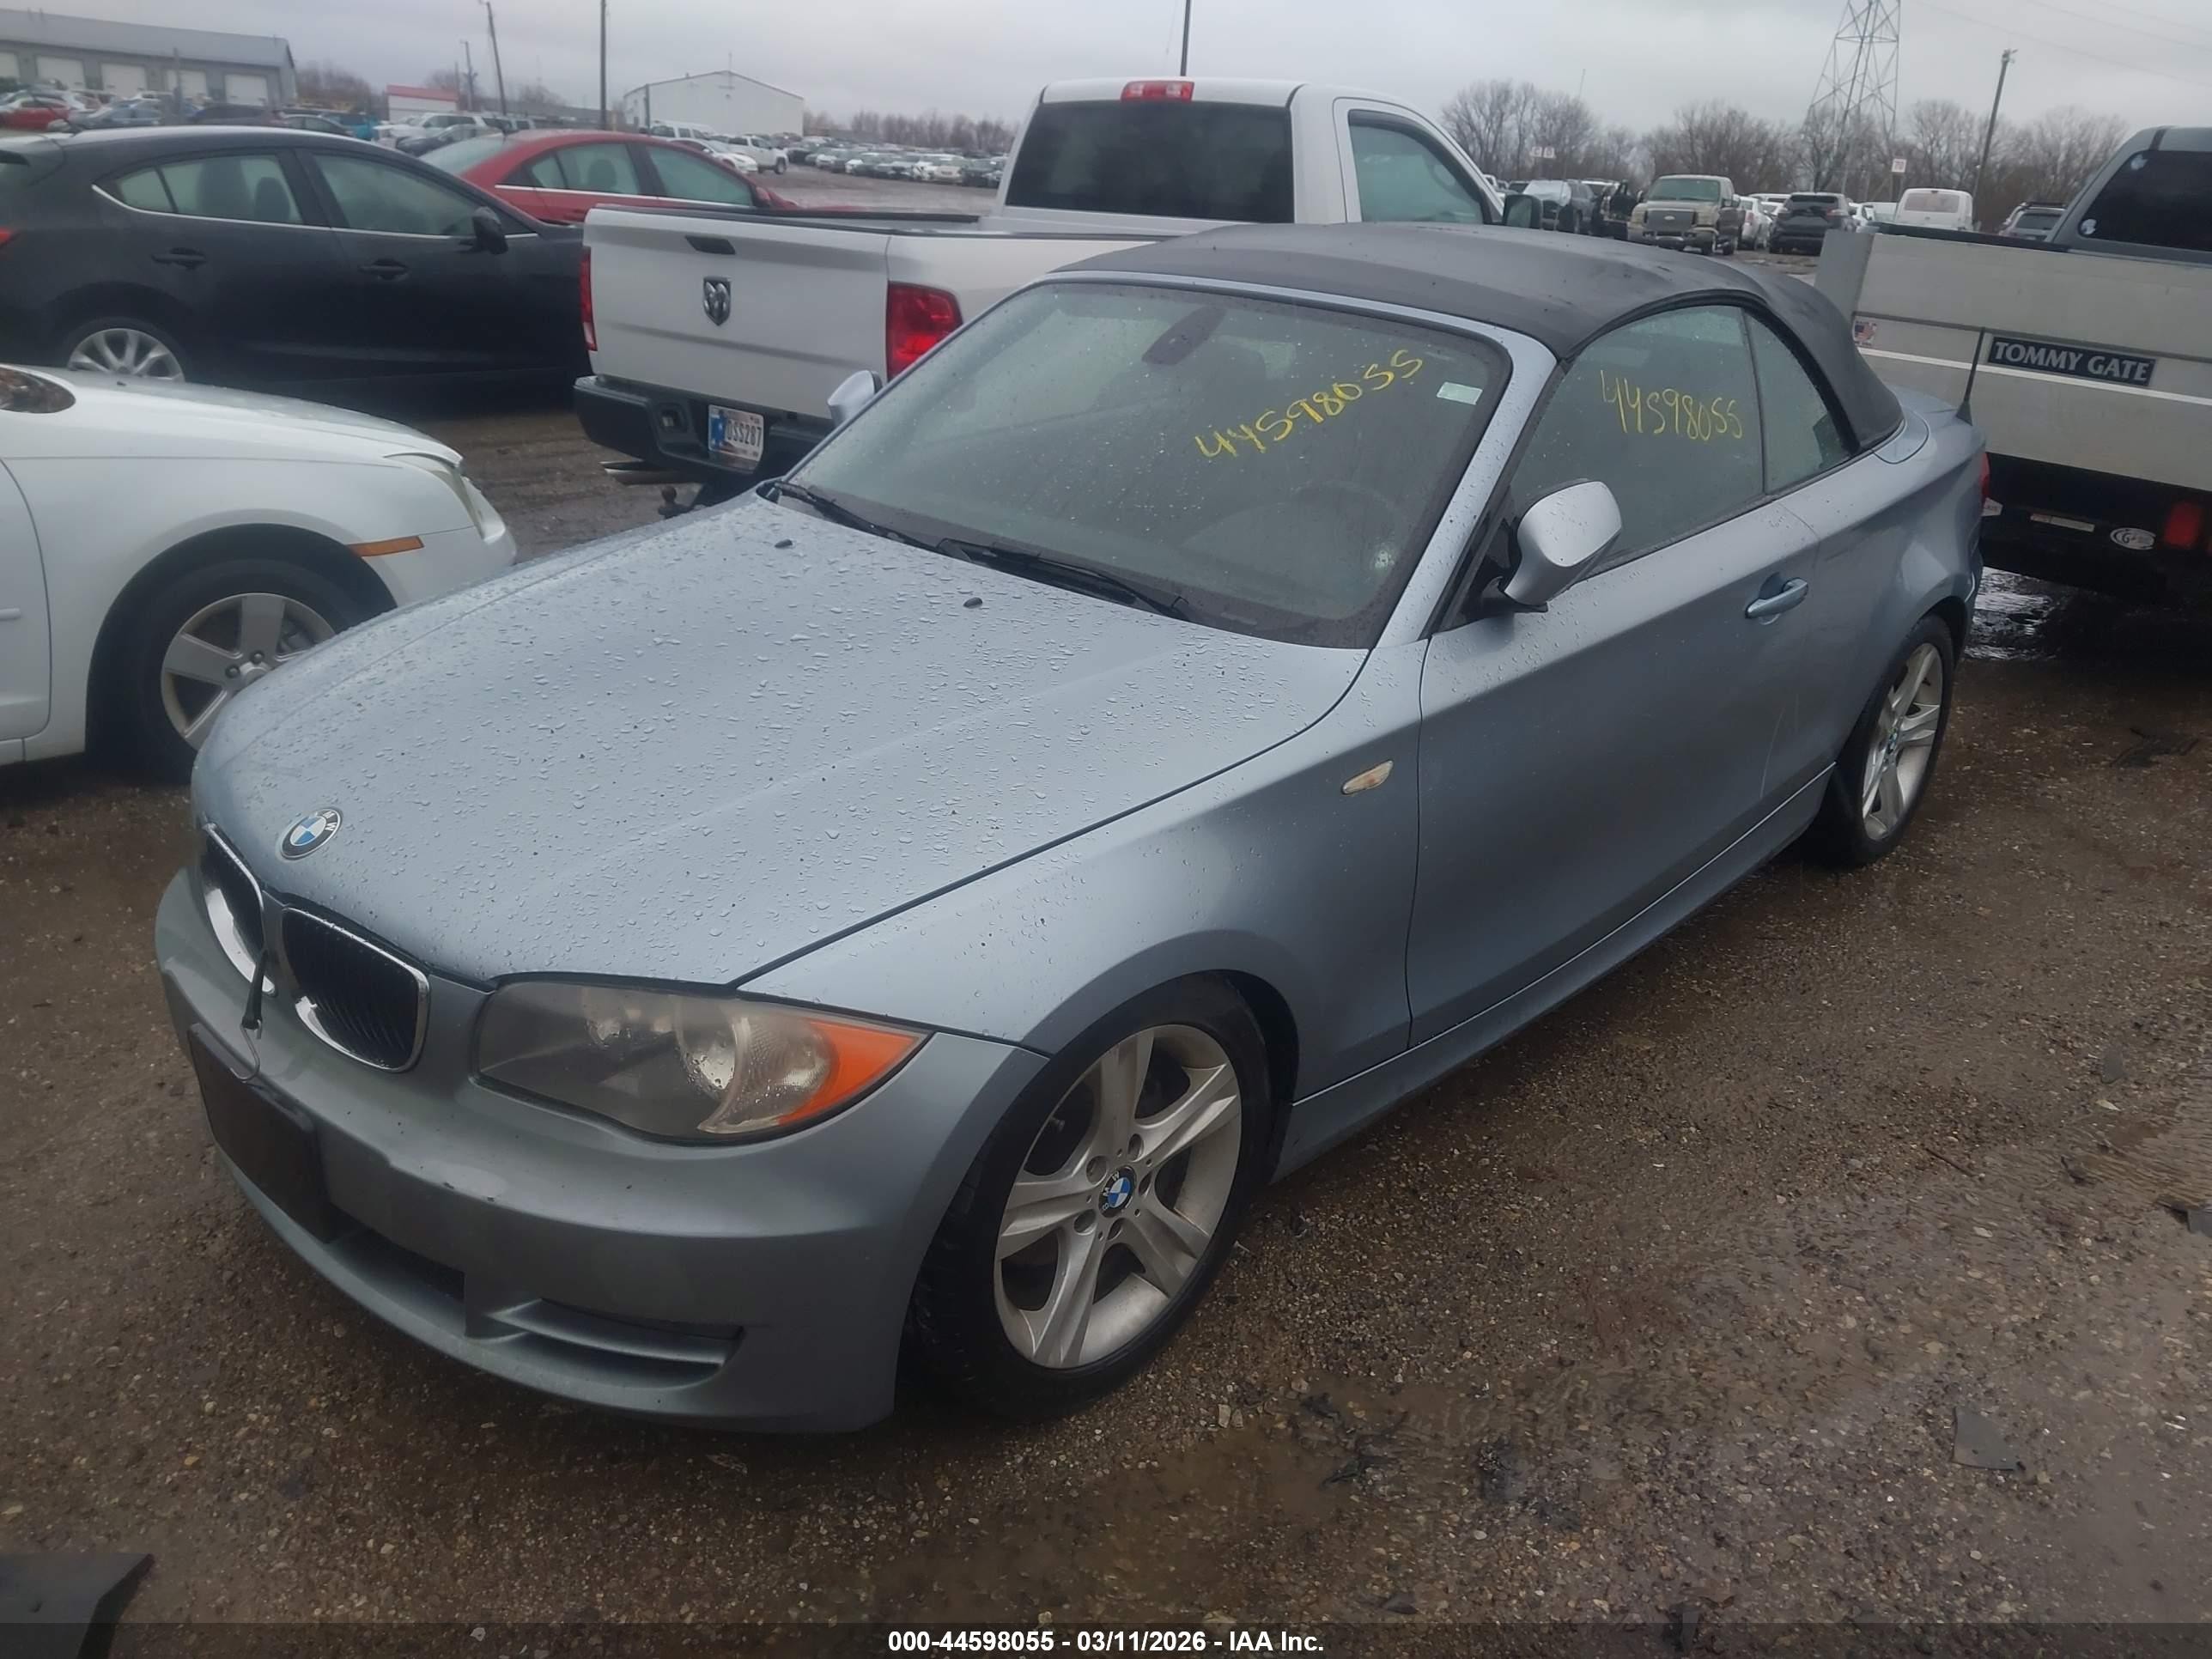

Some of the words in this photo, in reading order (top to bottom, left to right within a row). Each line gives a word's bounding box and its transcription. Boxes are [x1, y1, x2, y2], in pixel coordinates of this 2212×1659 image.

[1995, 341, 2083, 372] TOMMY
[2087, 356, 2150, 381] GATE
[1194, 349, 1423, 458] 44598055
[1600, 369, 1743, 441] 44598055
